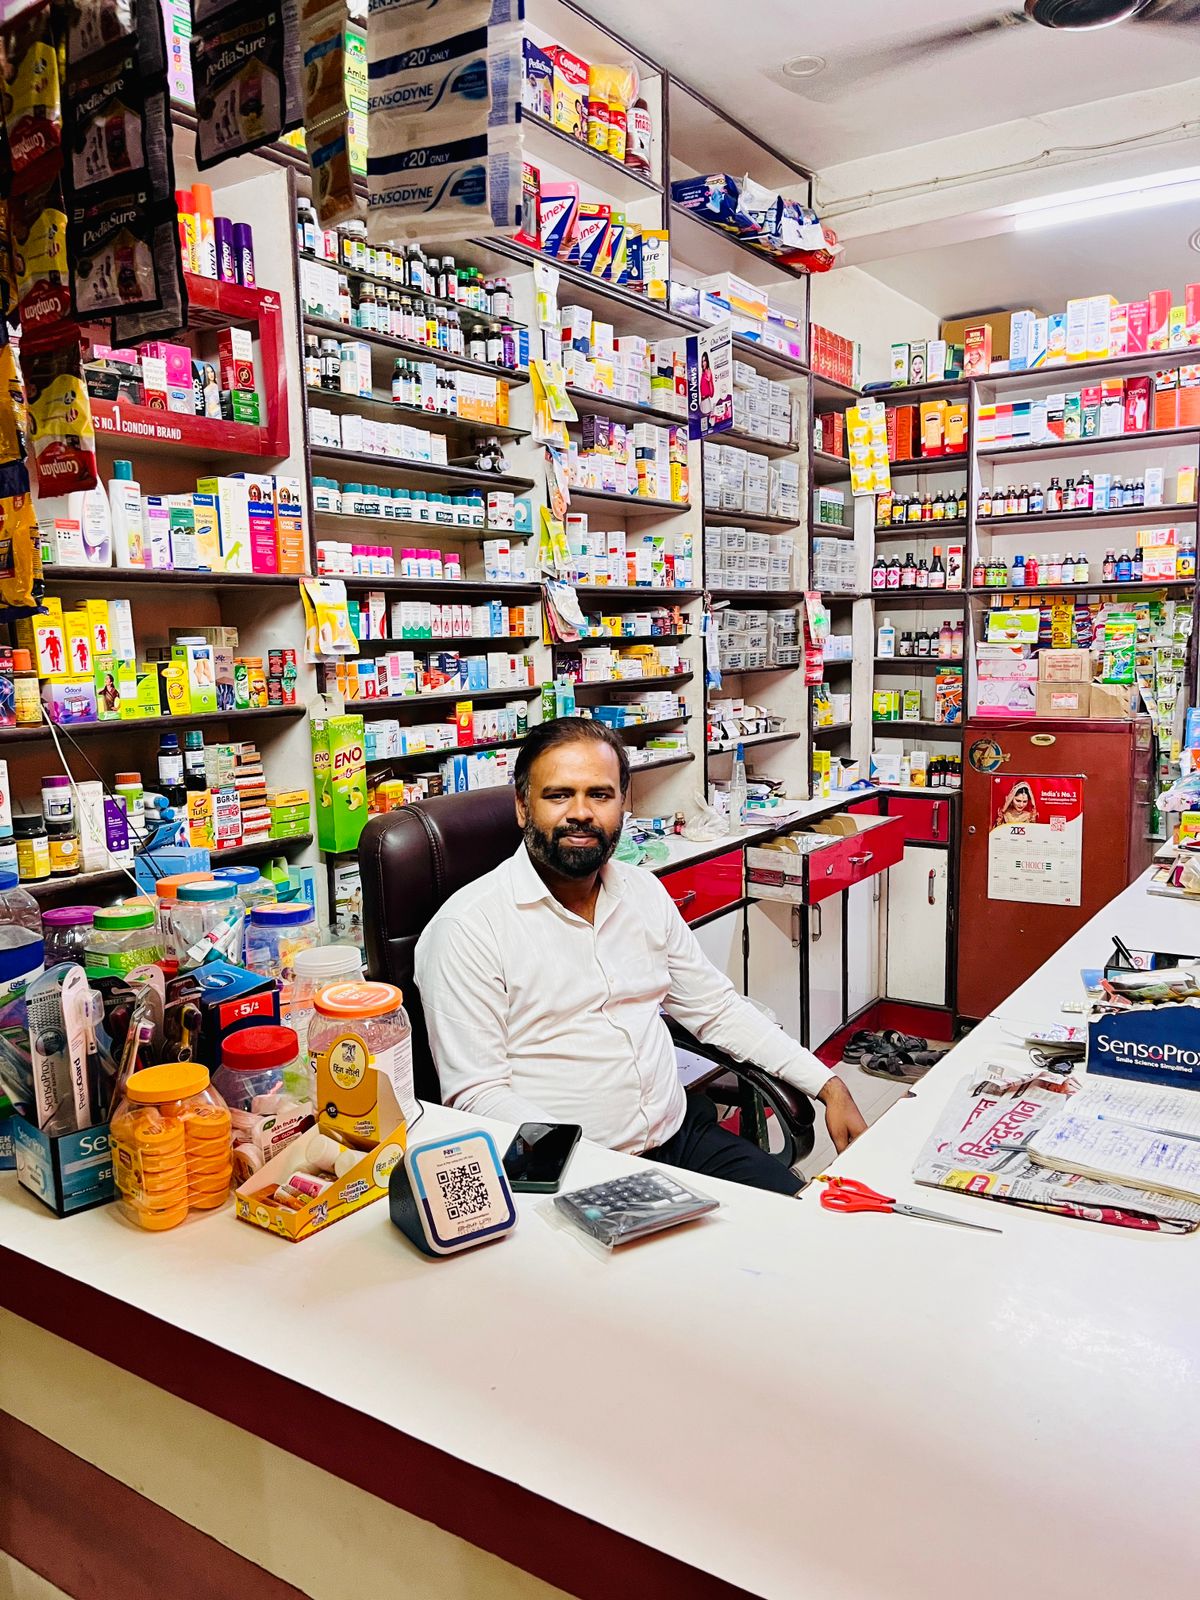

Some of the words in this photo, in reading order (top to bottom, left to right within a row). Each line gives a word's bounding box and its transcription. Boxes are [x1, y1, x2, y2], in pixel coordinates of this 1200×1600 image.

[206, 36, 266, 85] PediaSure
[429, 49, 450, 62] ONLY
[560, 54, 586, 80] Complan
[368, 83, 434, 110] SENSODYNE
[430, 153, 450, 164] ONLY
[368, 186, 434, 206] SENSODYNE
[83, 208, 136, 247] PediaSure
[24, 297, 62, 320] Complan
[1014, 322, 1023, 355] Bevon
[690, 366, 698, 392] News
[690, 392, 698, 412] Ova
[102, 417, 116, 430] NO.
[112, 405, 121, 432] 1
[122, 420, 154, 436] CONDOM
[156, 425, 182, 440] BRAND
[40, 459, 79, 478] Complan
[314, 752, 329, 762] ENO
[334, 746, 362, 769] ENO
[216, 793, 239, 804] BGR-34
[191, 805, 208, 816] Tulsi
[1010, 826, 1026, 836] 2025
[1116, 1056, 1134, 1064] Smile
[1134, 1058, 1159, 1068] Science
[1160, 1062, 1193, 1073] Simplified
[40, 1058, 54, 1112] SensoProx
[74, 1058, 86, 1110] PerioGard
